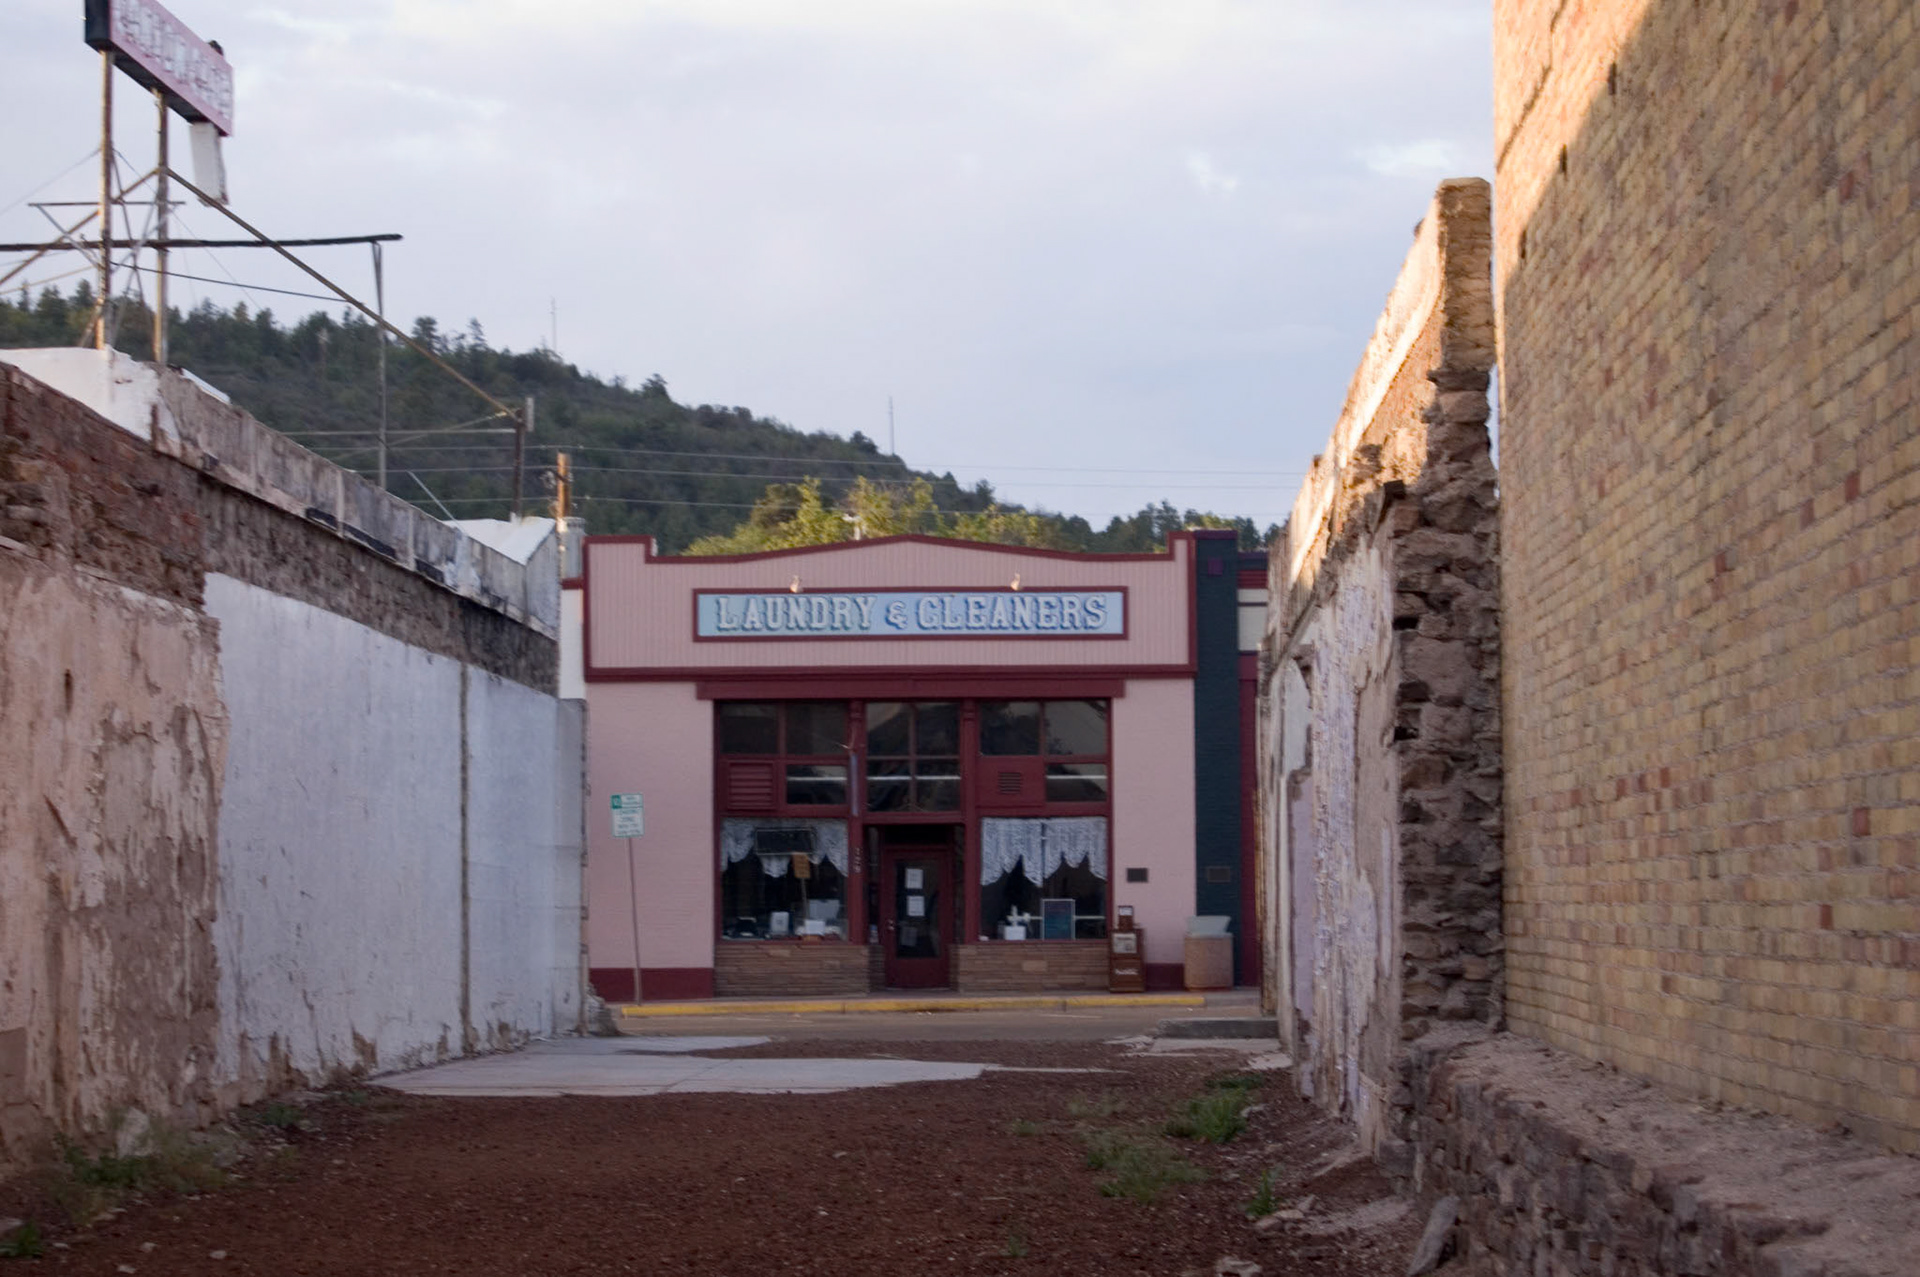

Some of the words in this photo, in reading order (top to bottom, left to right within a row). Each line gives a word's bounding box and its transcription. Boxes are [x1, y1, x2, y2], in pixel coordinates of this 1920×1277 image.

[716, 596, 876, 631] LAUNDRY
[885, 600, 907, 630] &
[917, 595, 1107, 630] CLEANERS
